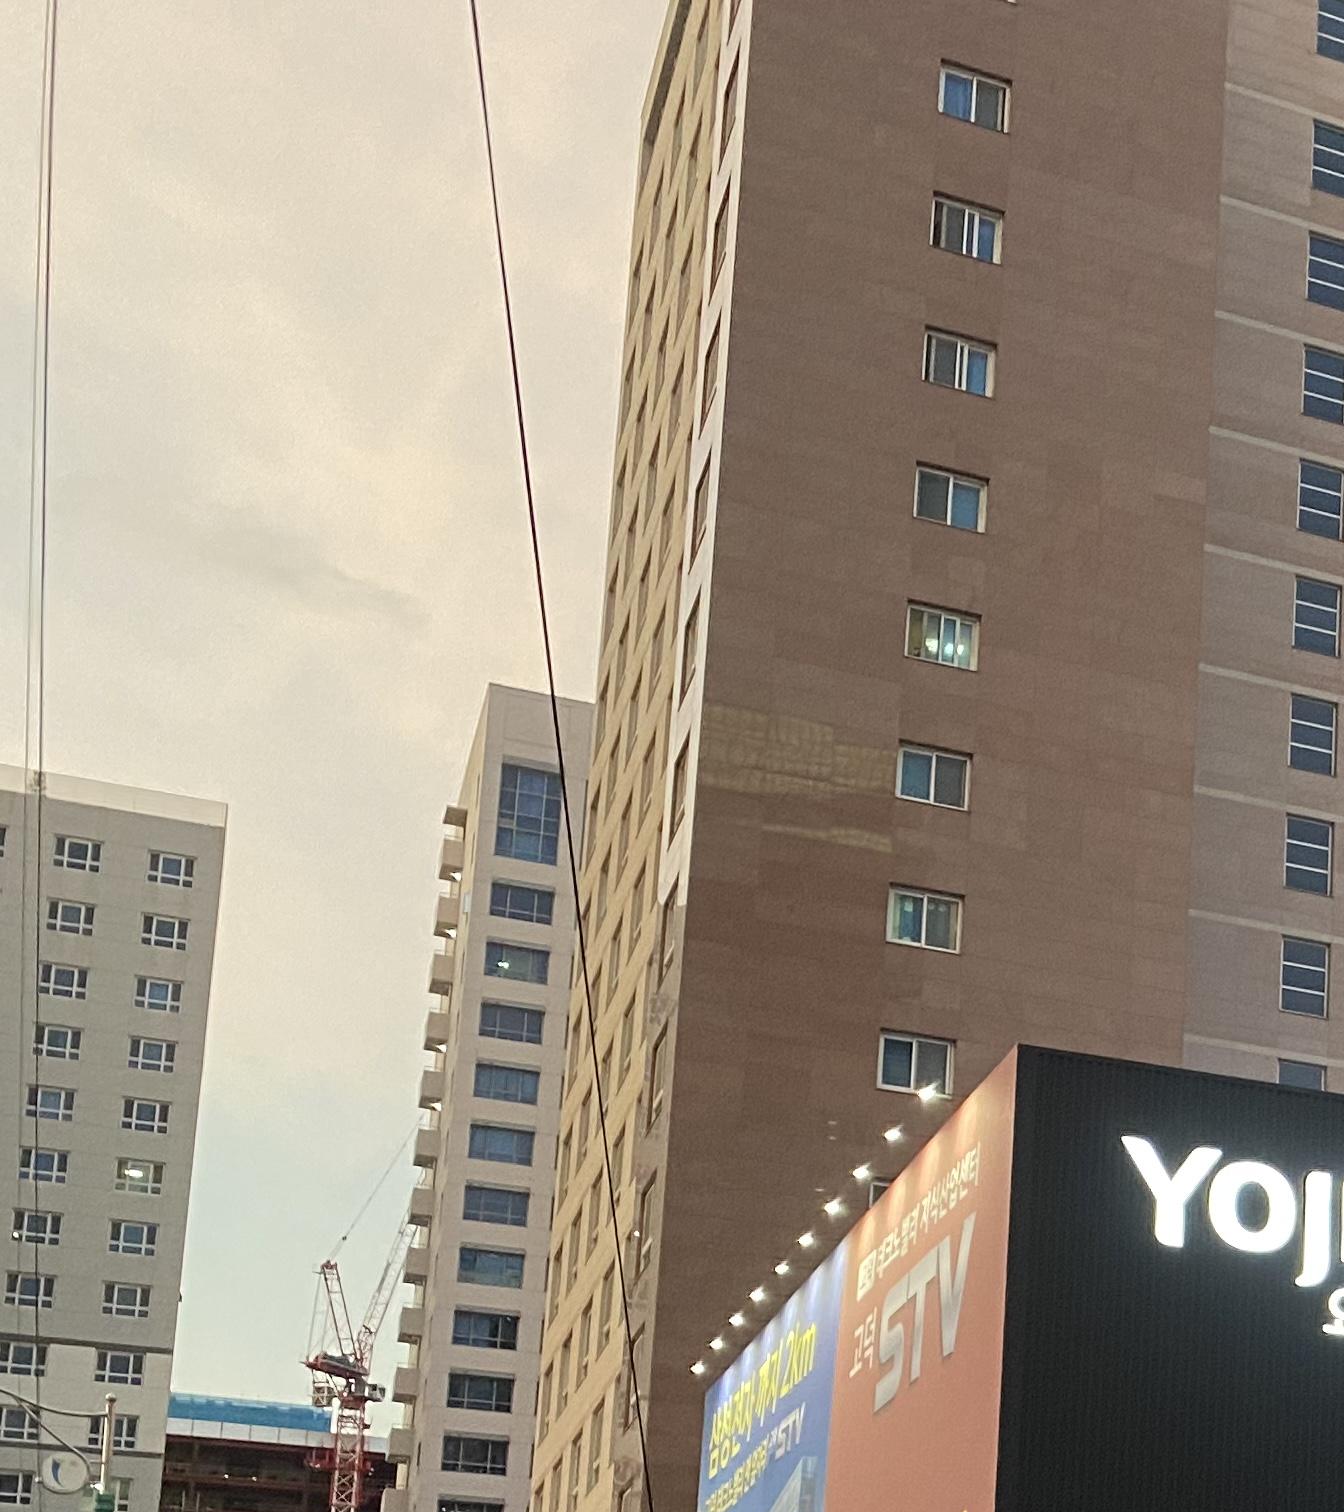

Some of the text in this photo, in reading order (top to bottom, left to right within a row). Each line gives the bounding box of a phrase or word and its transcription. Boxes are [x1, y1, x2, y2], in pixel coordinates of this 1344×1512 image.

[920, 1141, 981, 1233] 지식산업센터
[849, 1211, 976, 1414] 고덕 STV
[780, 1322, 816, 1399] 2km
